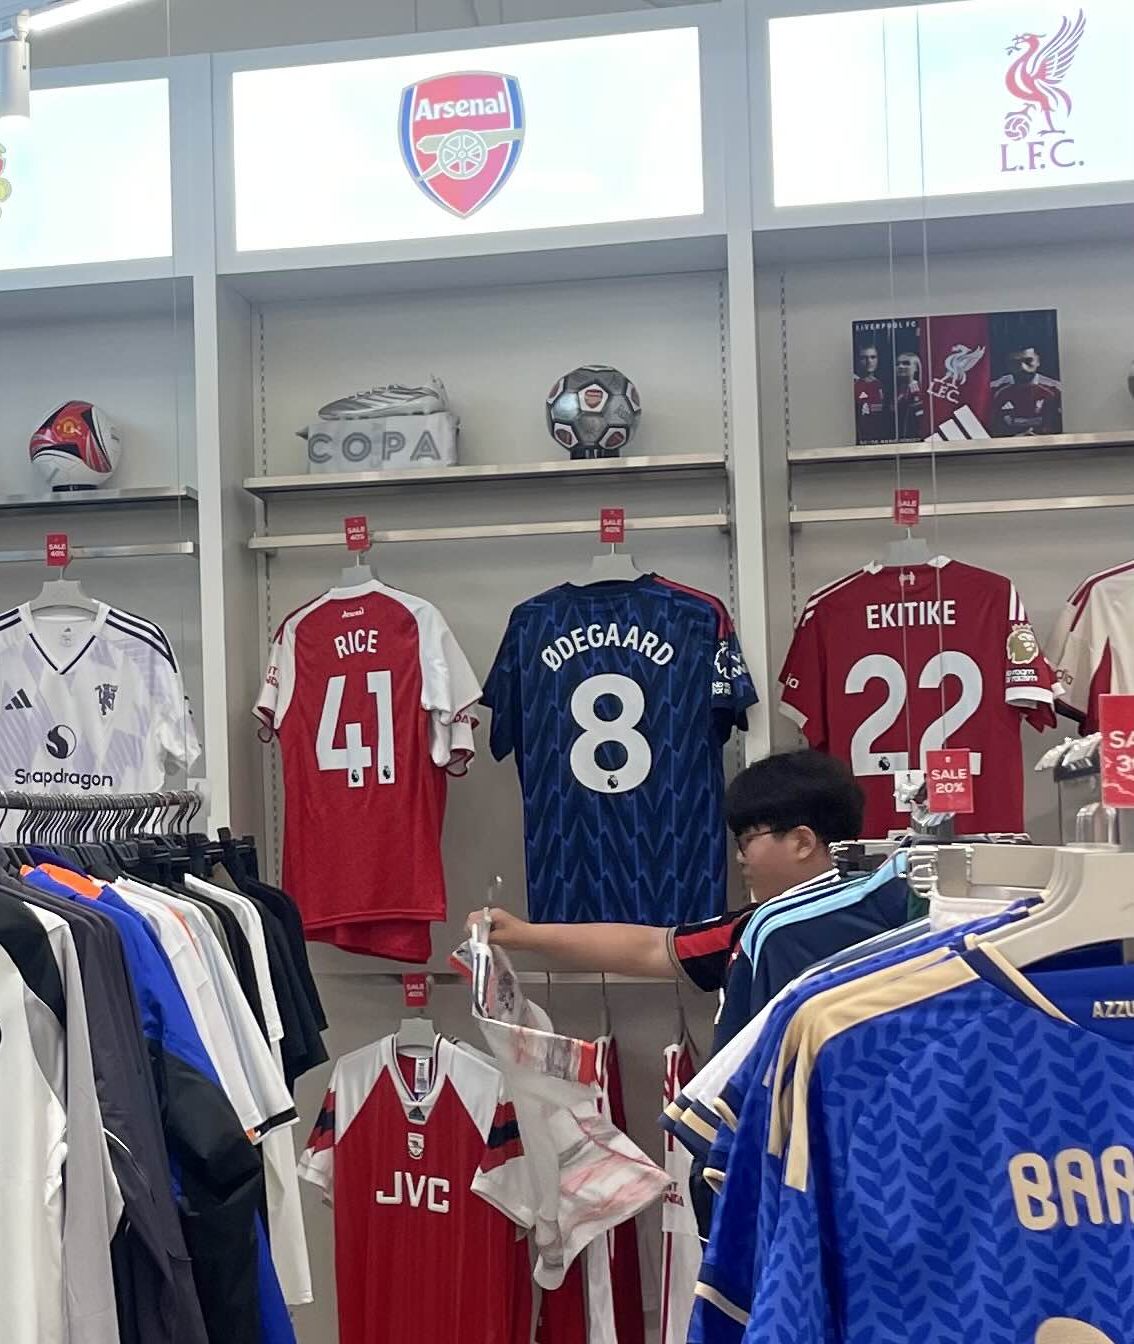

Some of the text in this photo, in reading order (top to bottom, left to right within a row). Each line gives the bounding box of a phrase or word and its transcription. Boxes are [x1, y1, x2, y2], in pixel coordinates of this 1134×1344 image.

[414, 91, 507, 121] Arsenal
[1000, 138, 1085, 173] L.F.C.
[308, 430, 442, 464] COPA
[347, 526, 365, 534] SALE
[602, 518, 623, 526] SALE
[48, 543, 67, 551] SALE
[866, 599, 957, 629] EKITIKE
[334, 629, 379, 659] RICE
[541, 622, 675, 672] ØDEGAARD
[845, 650, 983, 777] 22
[315, 670, 395, 788] 41
[569, 672, 653, 794] 8
[14, 768, 114, 790] Snapdragon
[931, 768, 967, 781] SALE
[935, 782, 965, 794] 20%
[375, 1170, 450, 1214] JVC
